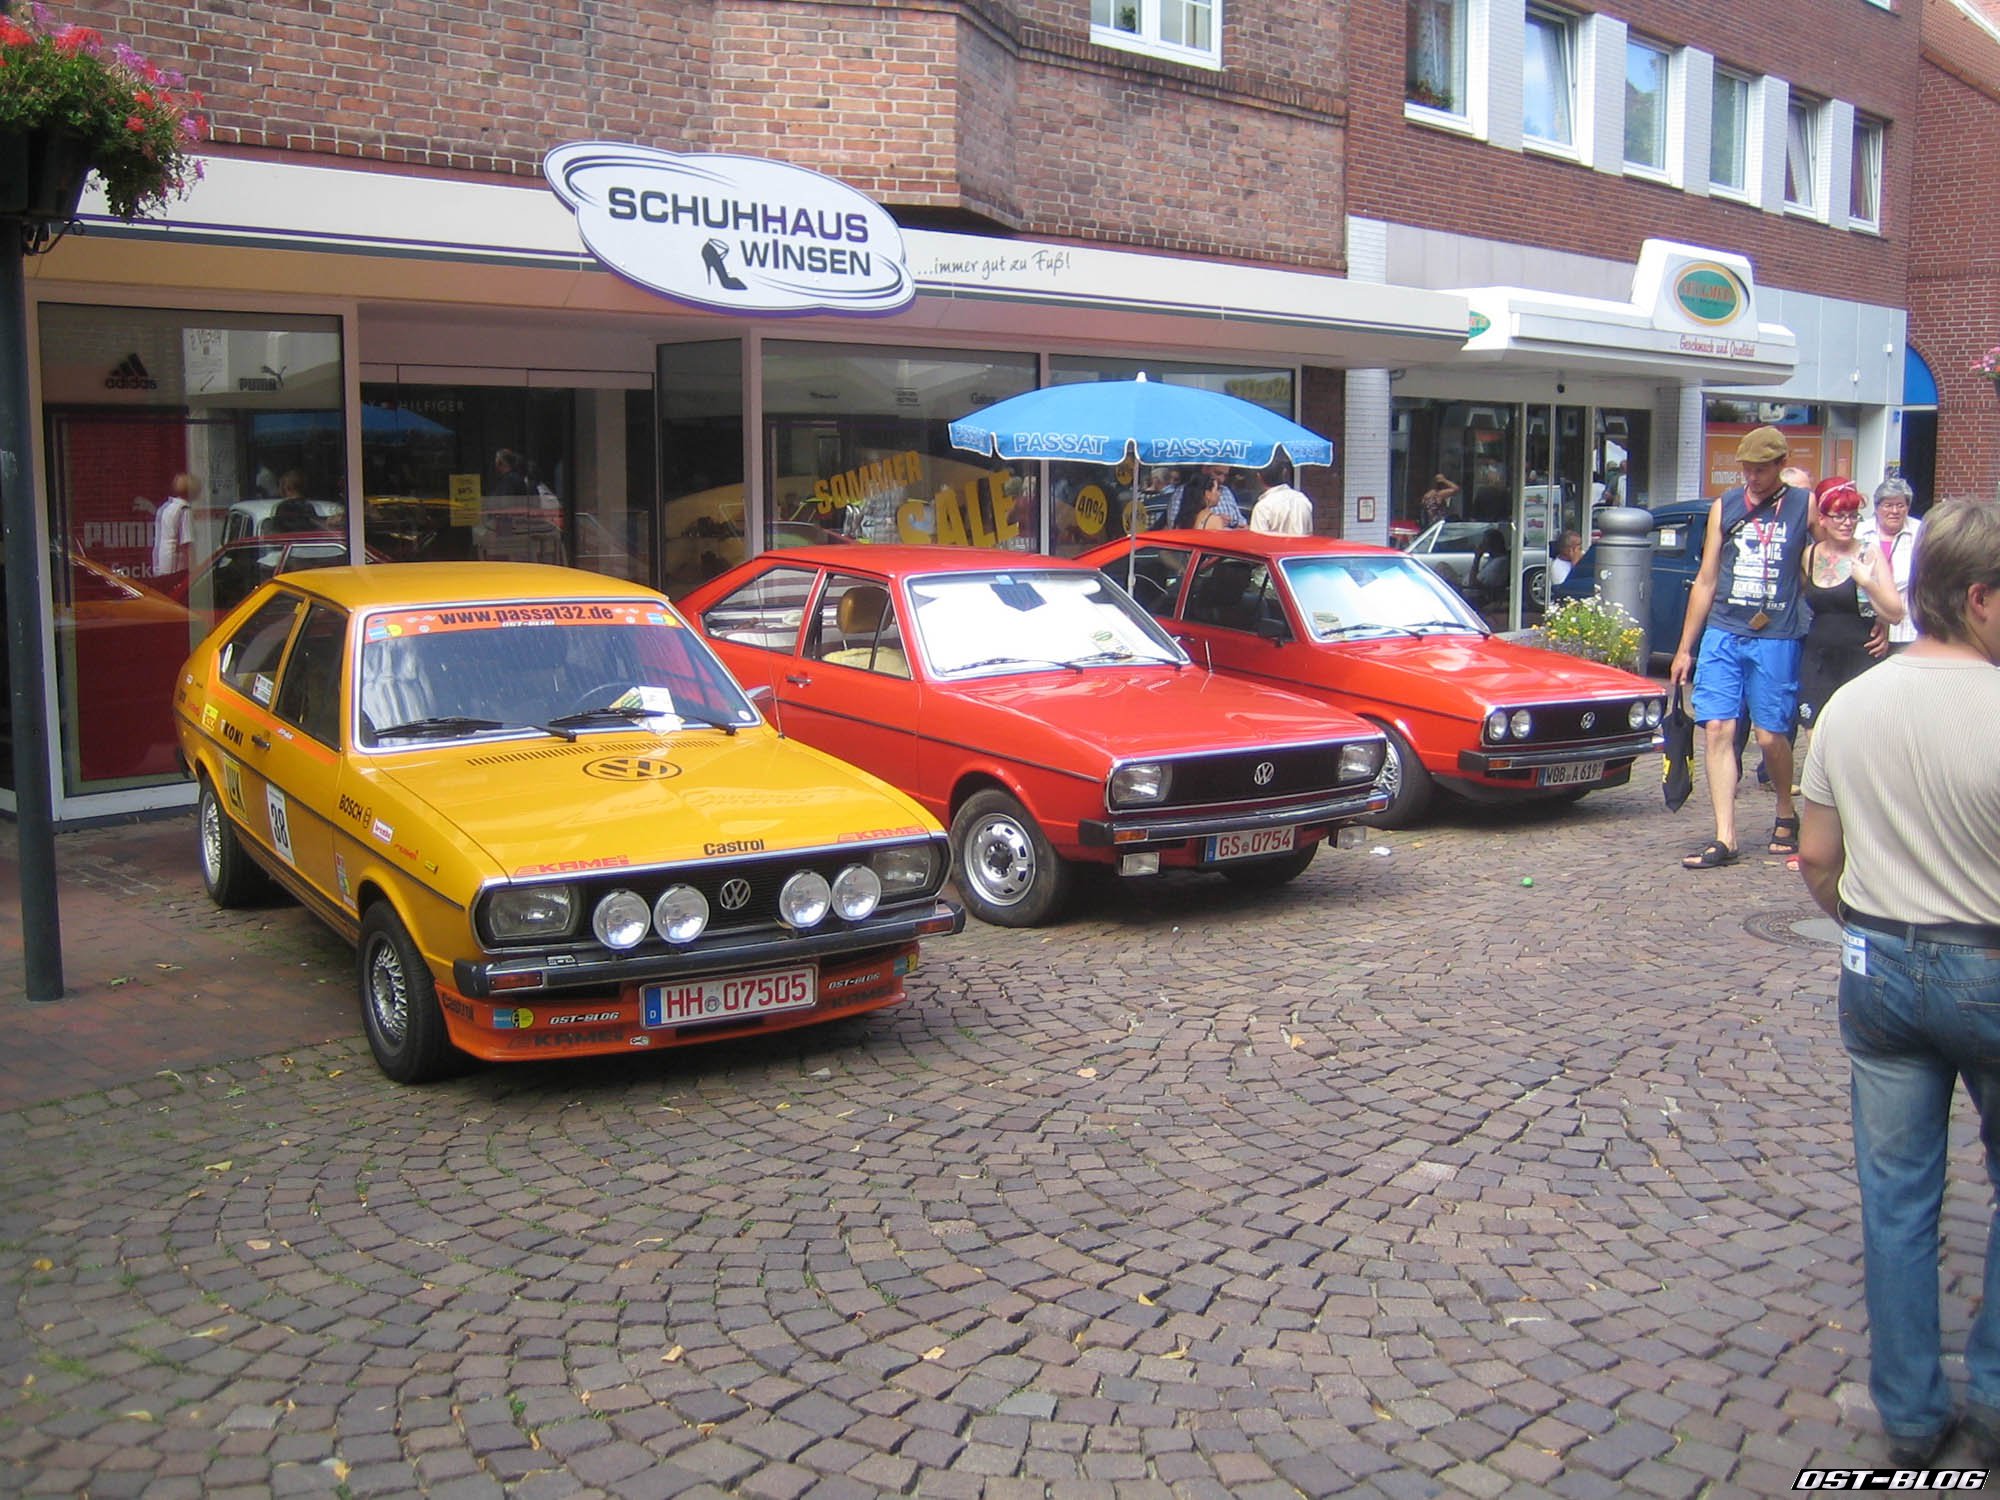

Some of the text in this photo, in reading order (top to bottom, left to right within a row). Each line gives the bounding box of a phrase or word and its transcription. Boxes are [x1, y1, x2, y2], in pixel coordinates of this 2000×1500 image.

[608, 186, 868, 243] SCHUHHAUS
[740, 231, 872, 276] WINSEN
[982, 259, 1006, 280] gut
[1010, 258, 1027, 270] zu
[1032, 249, 1070, 277] Fuß!
[104, 376, 158, 390] adidas
[400, 400, 464, 412] HILFIGER
[1013, 432, 1109, 455] PASSAT
[1151, 438, 1252, 460] PASSAT
[814, 450, 924, 514] SOMMER
[1077, 495, 1105, 522] 40%
[438, 604, 614, 626] www.passat32.de
[223, 722, 244, 747] KONI
[1546, 767, 1566, 783] WOB
[338, 794, 363, 821] BOSCH
[270, 803, 288, 849] 38
[854, 825, 926, 842] KAMEI
[703, 838, 765, 856] Castrol
[1219, 829, 1291, 857] GS 0754
[538, 854, 629, 873] KAMEI
[650, 973, 807, 1019] D HH 07505
[550, 1011, 620, 1025] OST-BLOG
